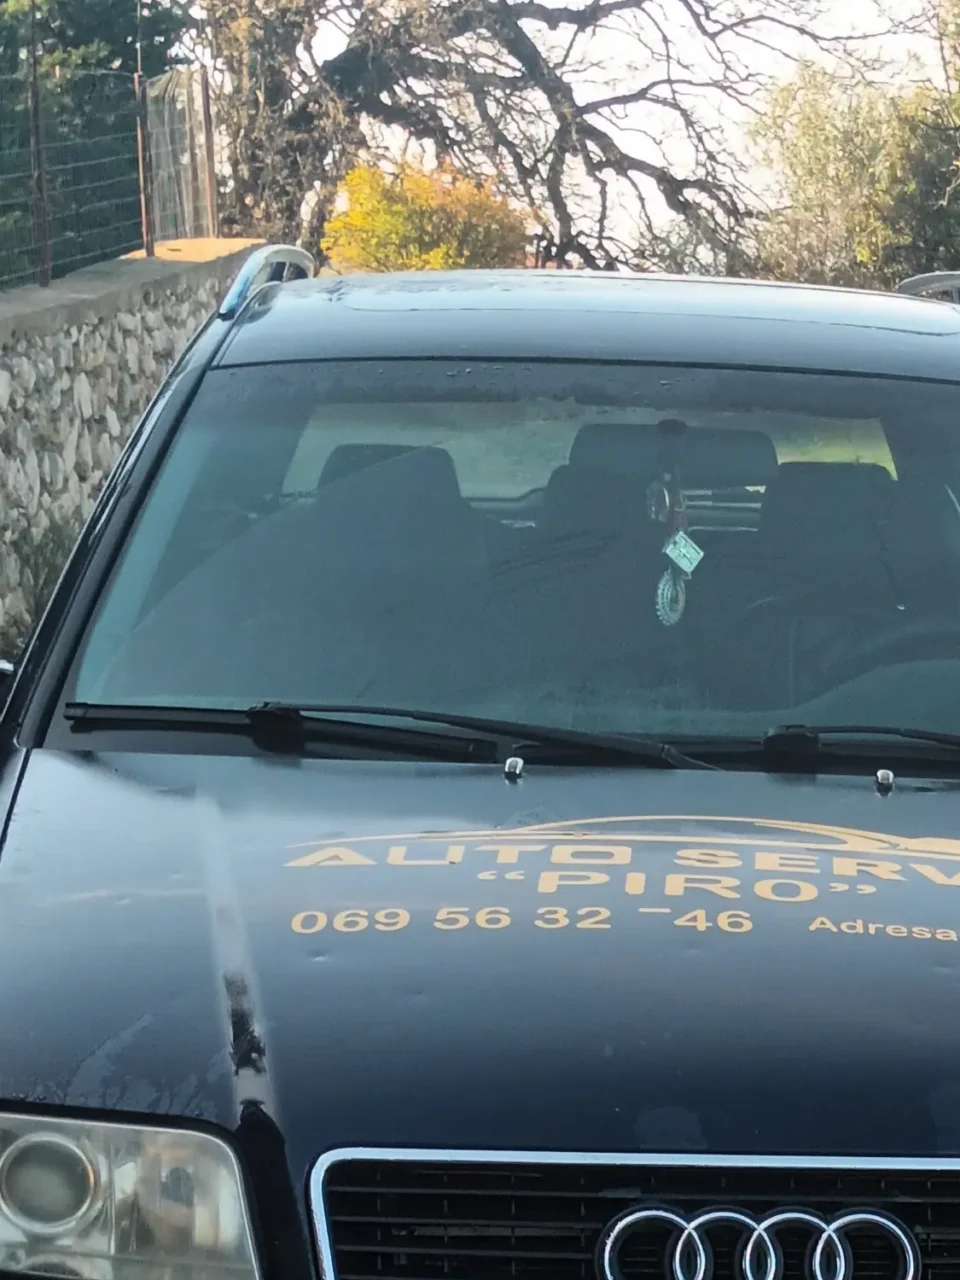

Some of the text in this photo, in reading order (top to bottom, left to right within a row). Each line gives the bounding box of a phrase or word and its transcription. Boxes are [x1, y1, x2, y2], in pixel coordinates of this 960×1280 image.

[284, 845, 632, 867] AUTO
[477, 870, 877, 902] “PIRO”
[291, 908, 411, 934] 069
[433, 906, 512, 930] 56
[534, 906, 611, 929] 32
[808, 916, 958, 942] Adresa
